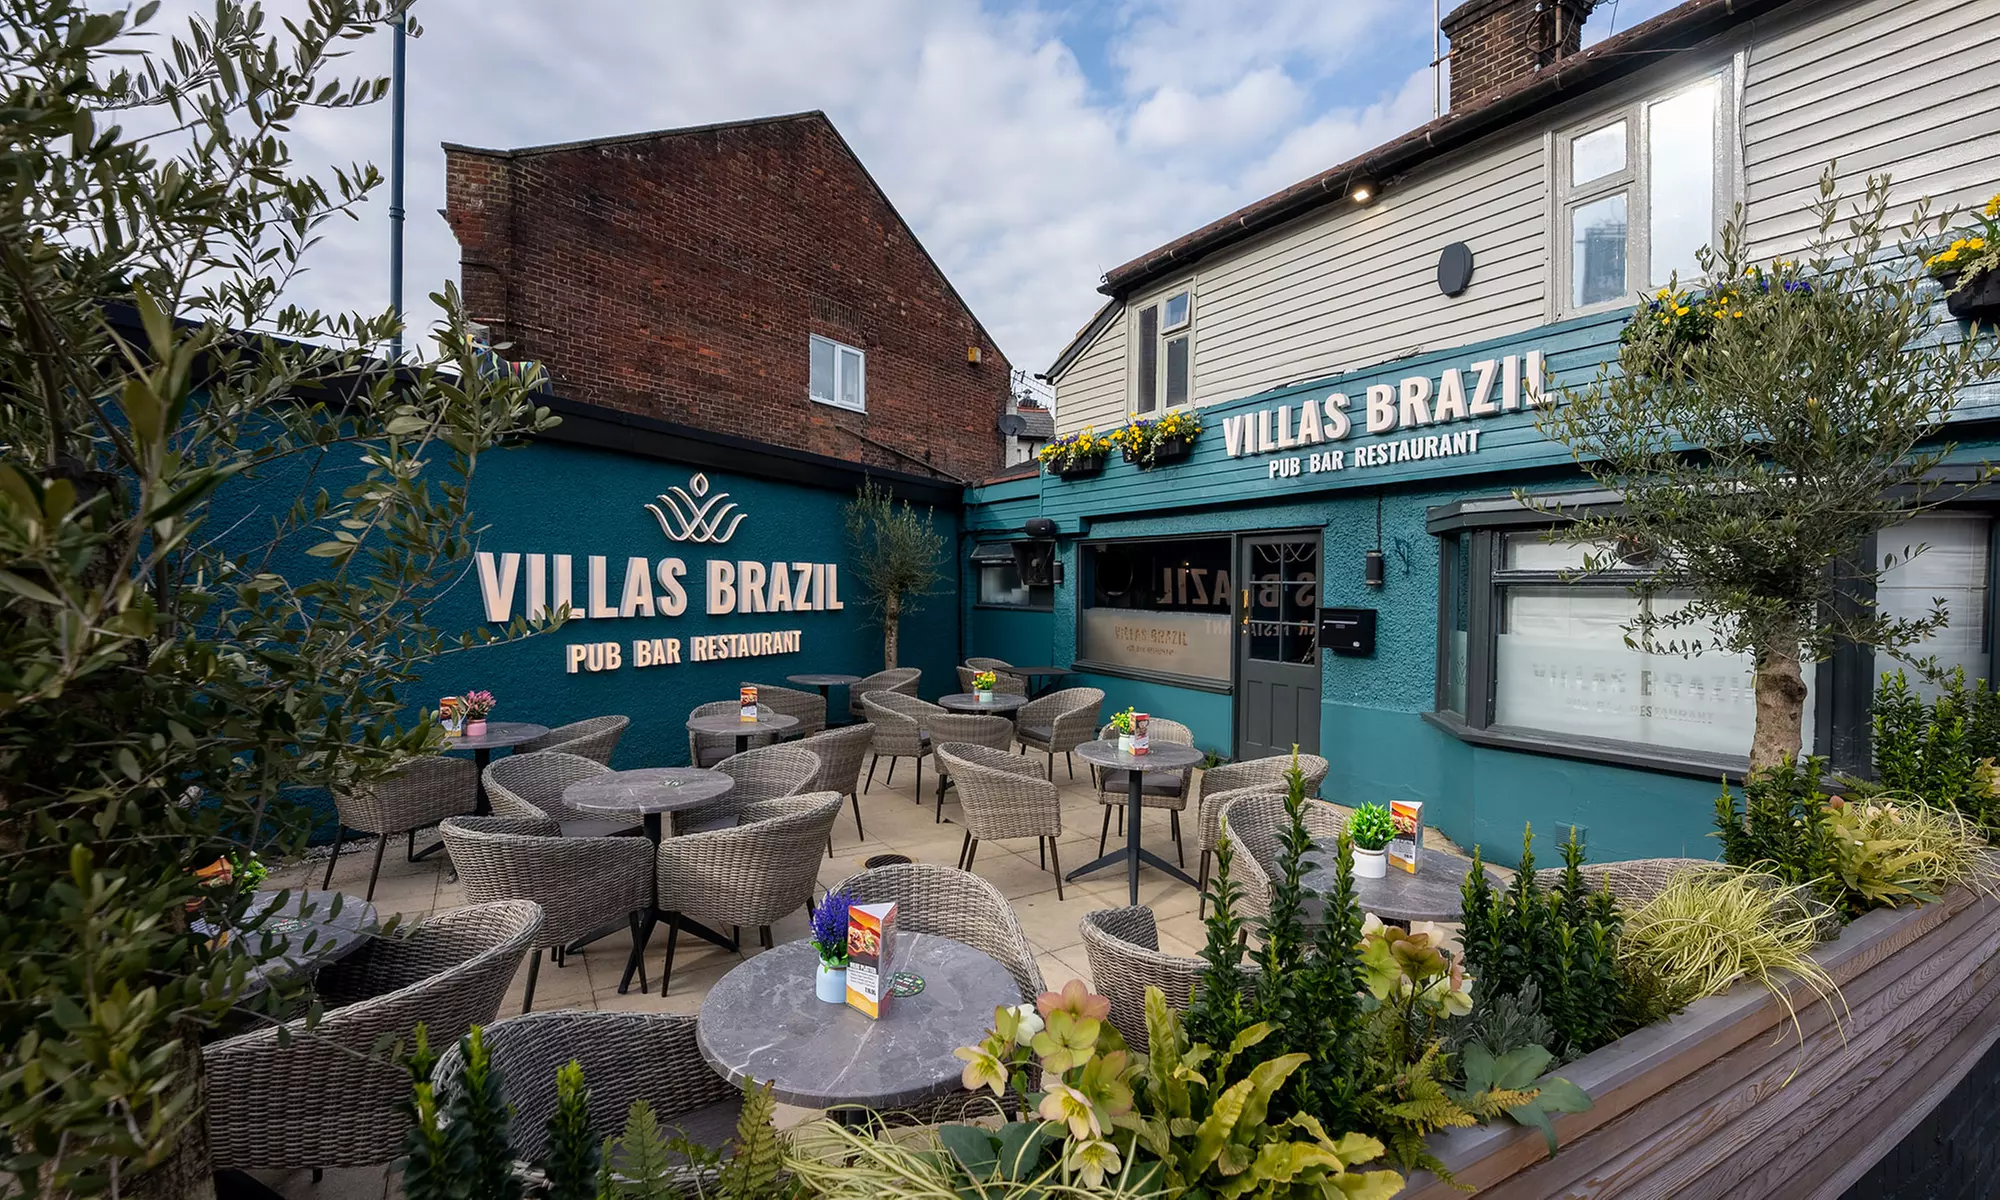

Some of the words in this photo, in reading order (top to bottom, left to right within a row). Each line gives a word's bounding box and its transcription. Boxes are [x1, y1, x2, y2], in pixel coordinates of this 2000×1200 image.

[1223, 392, 1350, 457] VILLAS
[1366, 350, 1557, 433] BRAZIL
[1269, 456, 1301, 479] PUB
[1309, 451, 1344, 472] BAR
[1354, 429, 1481, 468] RESTAURANT
[475, 551, 687, 622] VILLAS
[706, 559, 844, 616] BRAZIL
[566, 642, 621, 674] PUB
[633, 637, 680, 668] BAR
[690, 629, 802, 662] RESTAURANT
[1150, 628, 1188, 646] BRAZIL
